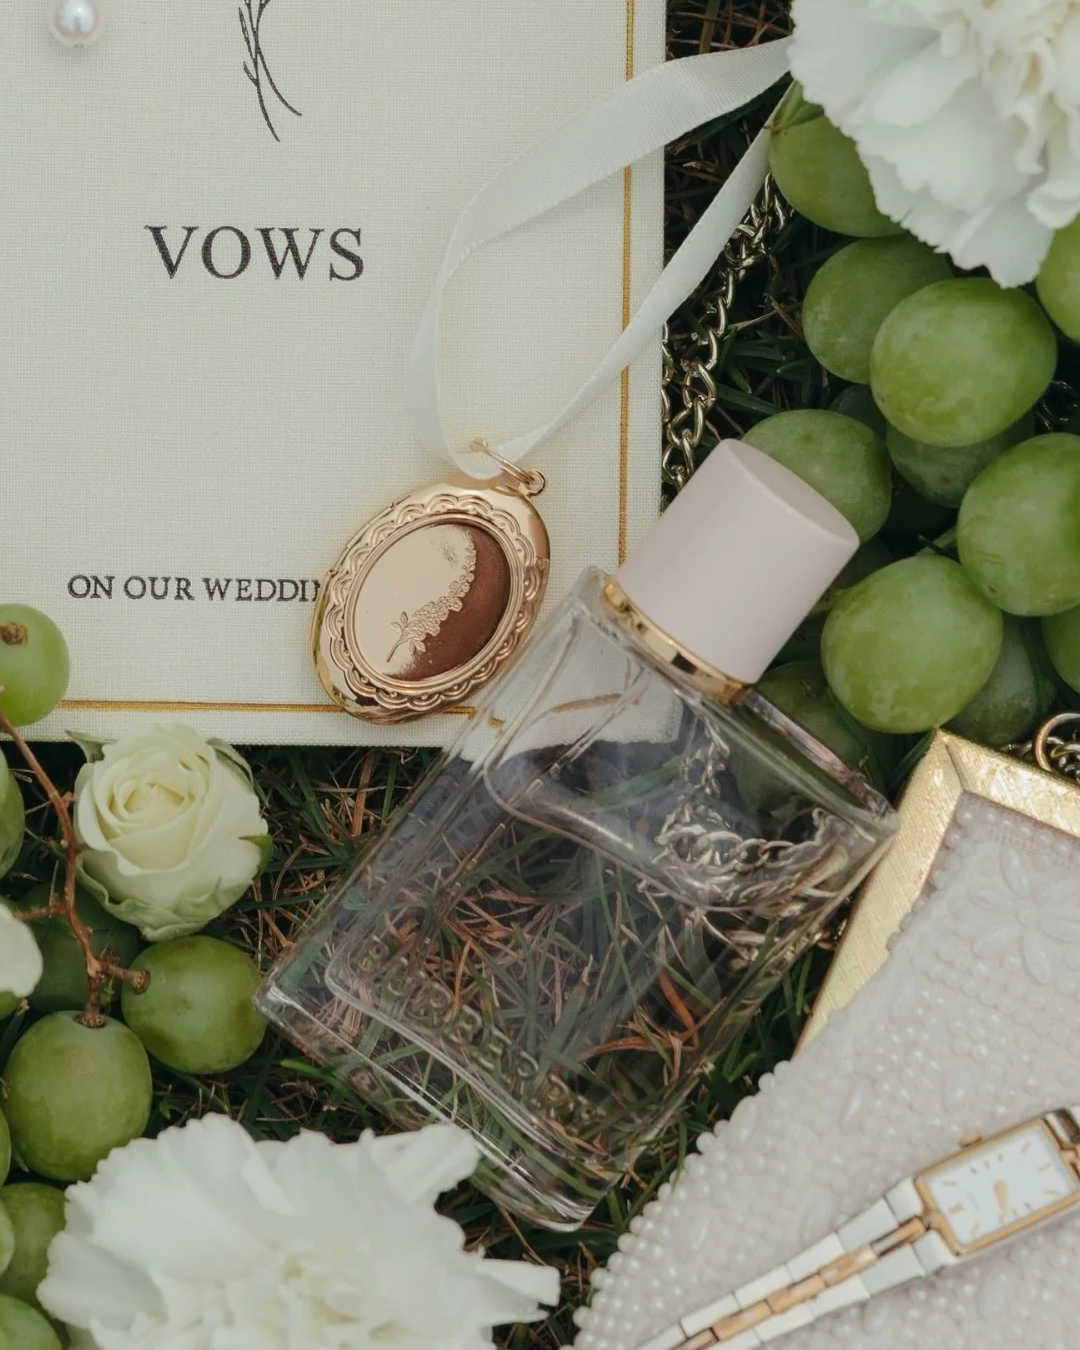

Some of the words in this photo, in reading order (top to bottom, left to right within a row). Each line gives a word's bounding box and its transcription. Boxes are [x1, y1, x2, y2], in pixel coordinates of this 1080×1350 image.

[143, 224, 365, 282] VOWS
[67, 574, 116, 600] ON
[123, 575, 195, 601] OUR
[347, 933, 610, 1132] BURBERRY
